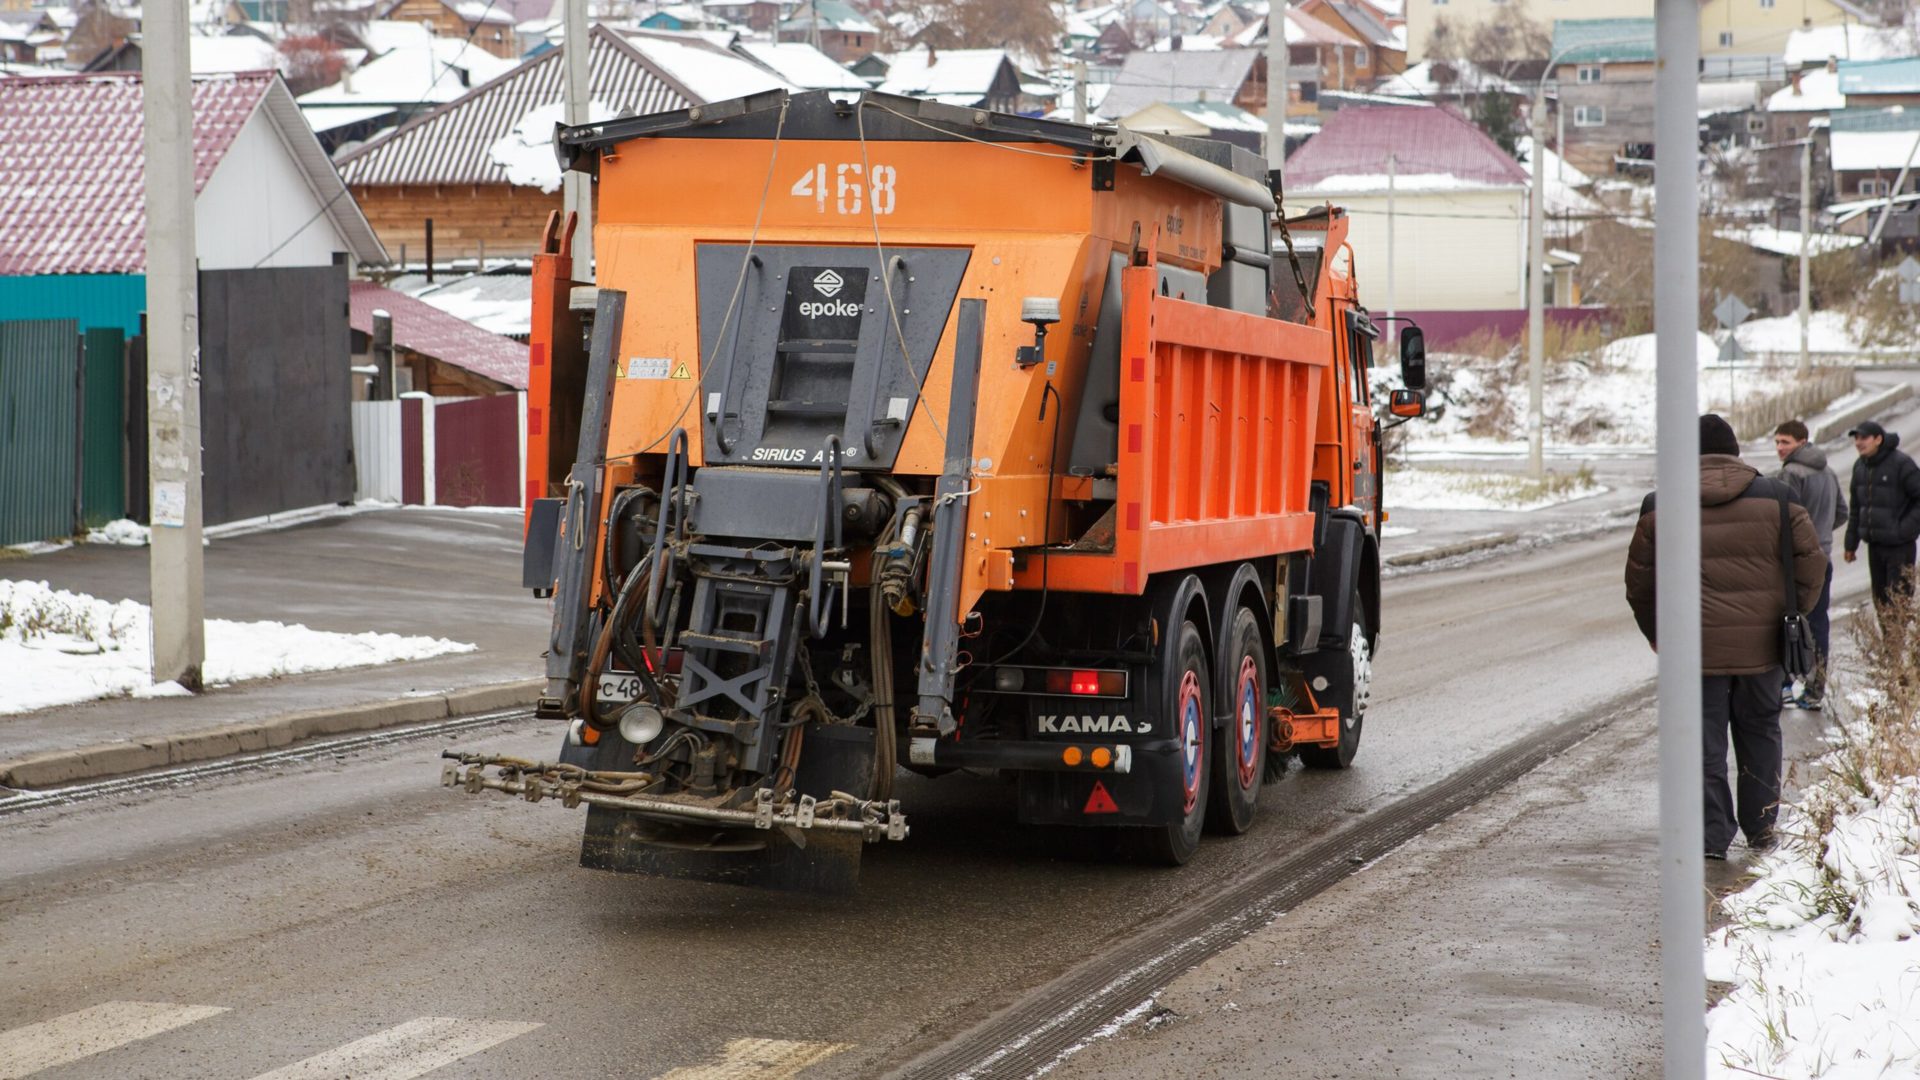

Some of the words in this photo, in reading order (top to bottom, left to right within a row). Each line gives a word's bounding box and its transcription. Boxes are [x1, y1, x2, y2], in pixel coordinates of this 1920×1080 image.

[791, 163, 896, 215] 468
[752, 448, 807, 462] SIRIUS
[602, 678, 645, 699] С48
